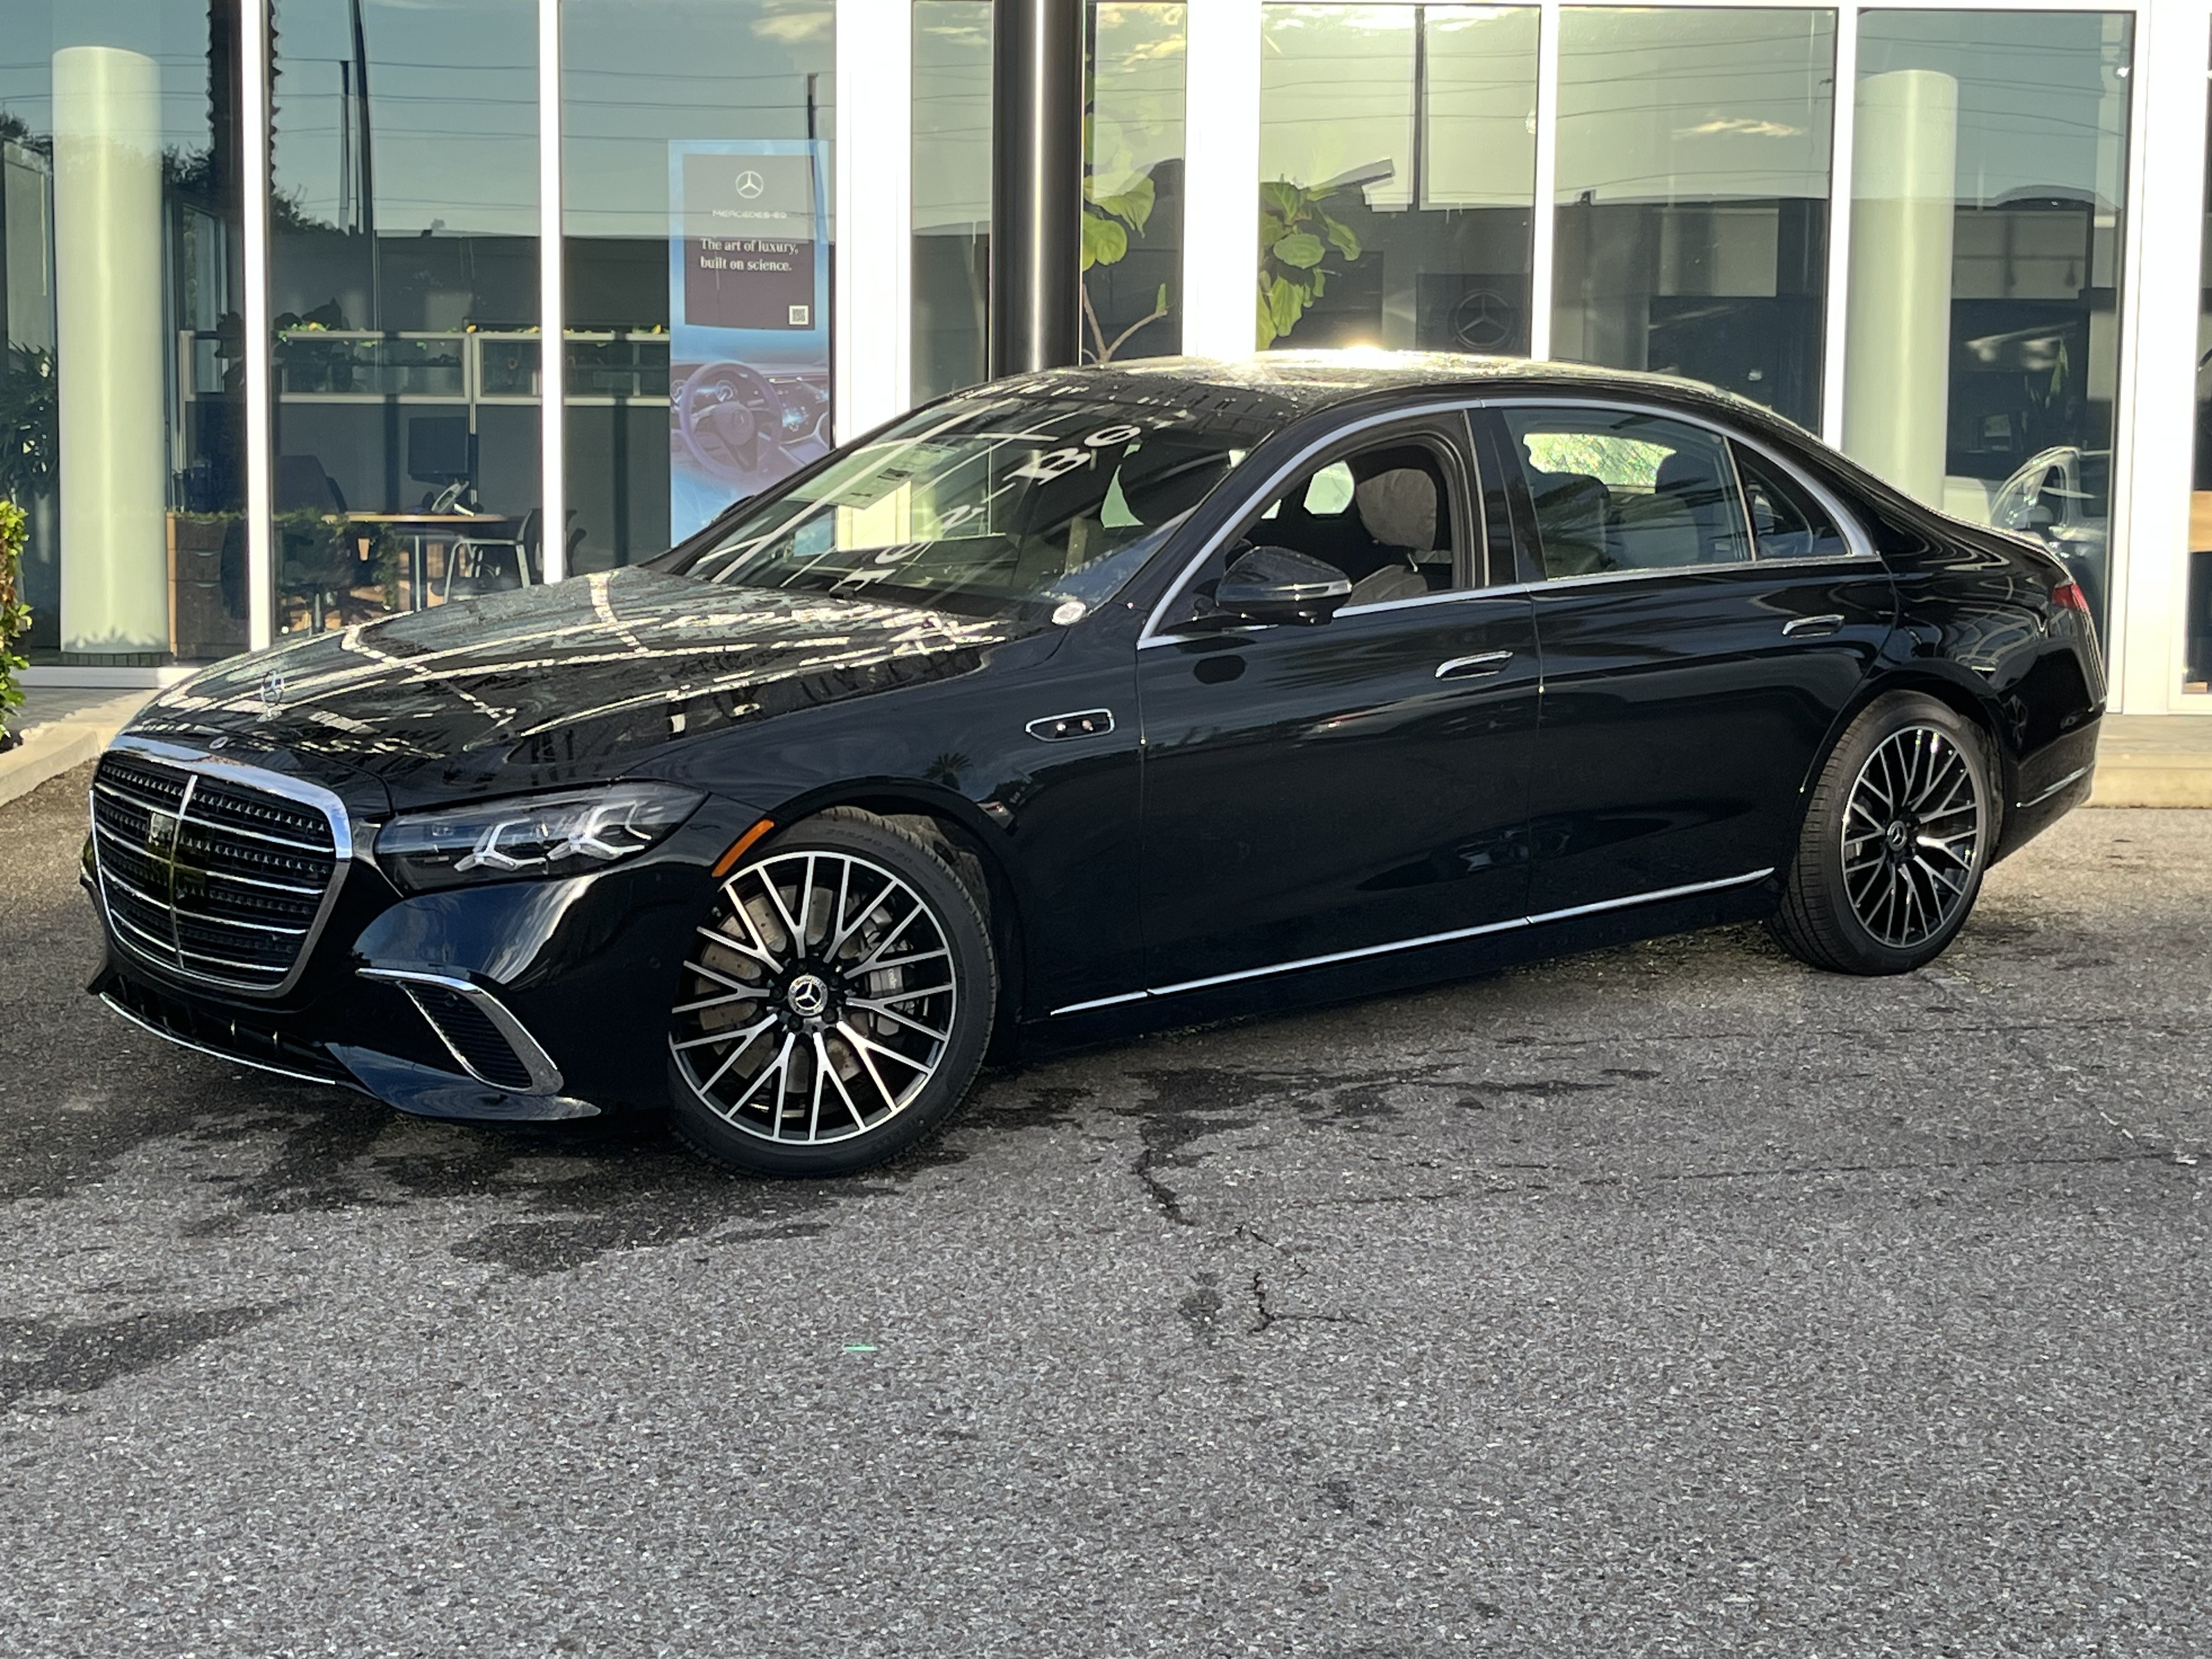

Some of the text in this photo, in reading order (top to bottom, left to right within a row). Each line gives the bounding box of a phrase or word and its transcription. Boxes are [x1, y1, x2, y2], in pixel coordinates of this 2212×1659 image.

[699, 238, 799, 255] The art of luxury,
[699, 256, 793, 271] built on science.
